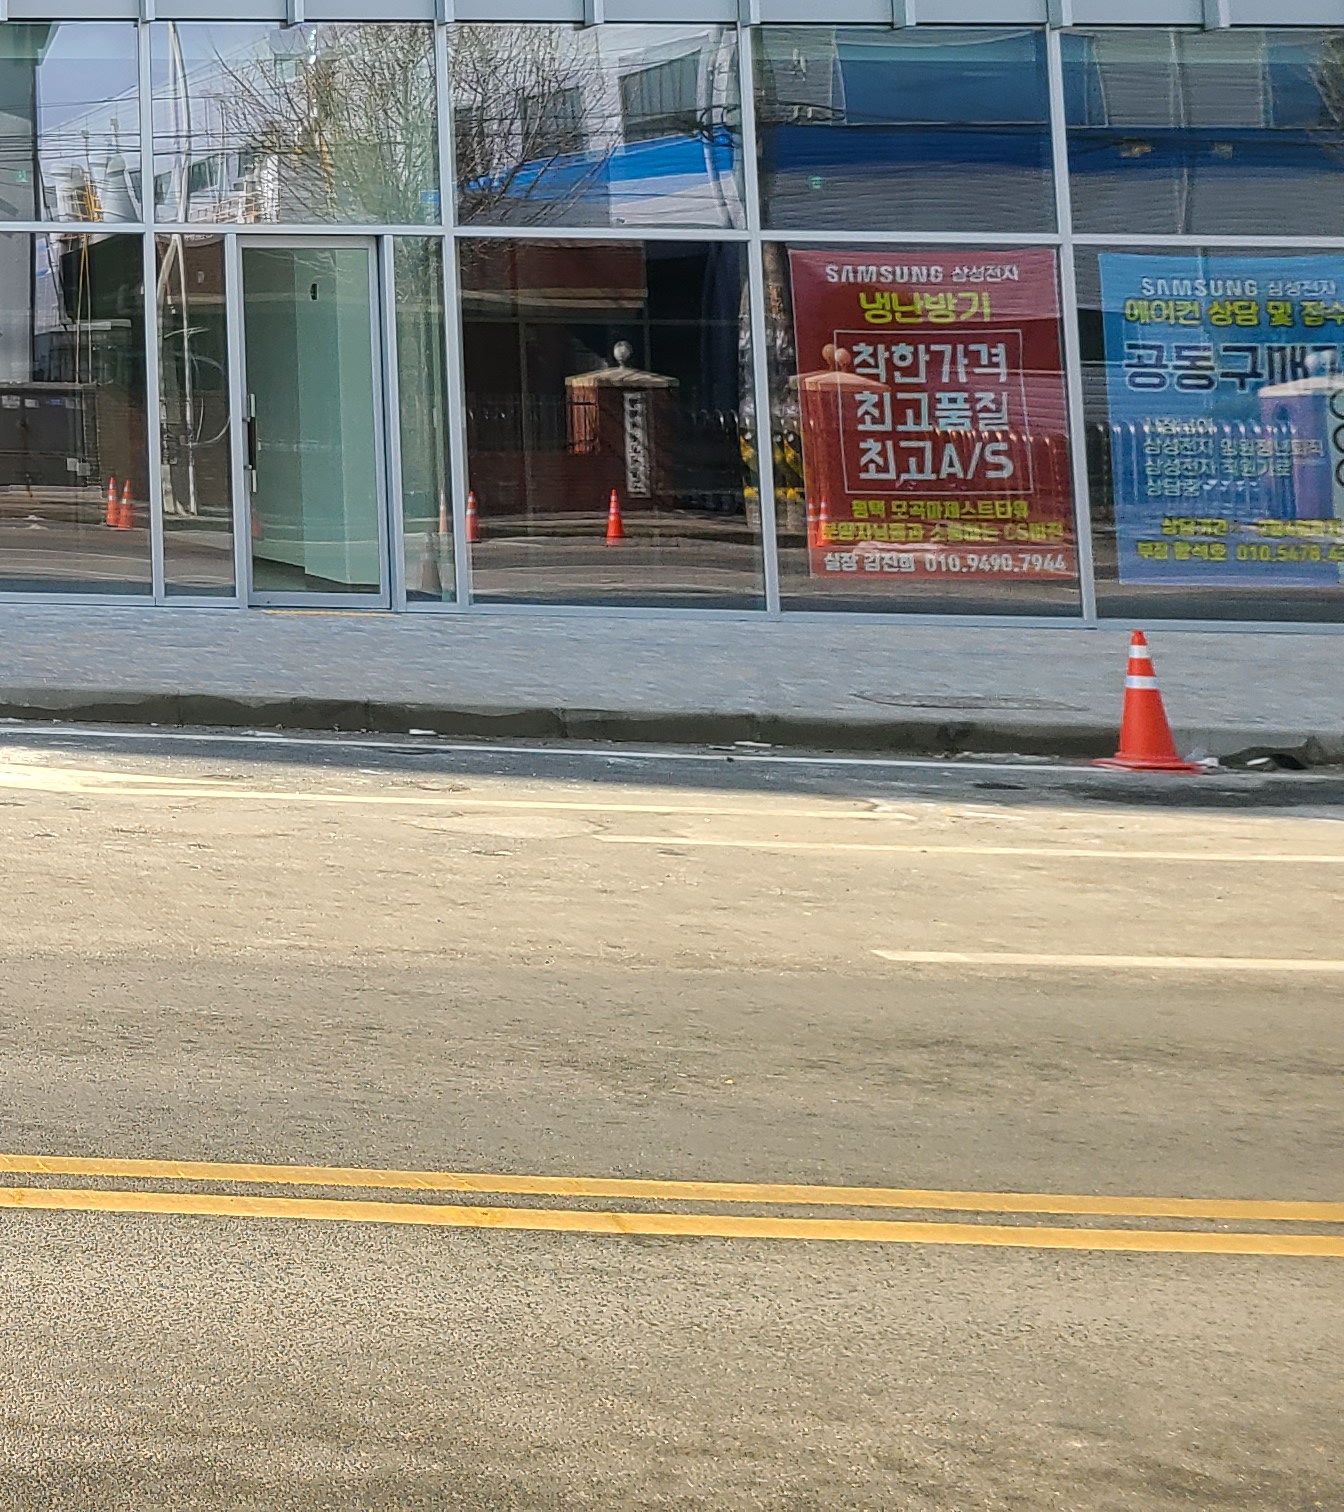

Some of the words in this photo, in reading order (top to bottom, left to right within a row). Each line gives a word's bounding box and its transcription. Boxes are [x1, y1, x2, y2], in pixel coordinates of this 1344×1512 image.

[825, 265, 944, 283] SAMSUNG
[951, 264, 1019, 282] 삼성전자
[1141, 277, 1258, 296] SAMSUNG
[1267, 280, 1336, 297] 삼성전자
[859, 291, 991, 324] 냉난방기
[1125, 298, 1201, 325] 에어컨
[1208, 300, 1259, 326] 상담
[1266, 300, 1294, 326] 및
[852, 341, 1008, 384] 착한가격
[855, 390, 1010, 432] 최고품질
[859, 439, 1015, 481] 최고A/S
[1144, 438, 1214, 456] 삼성전자
[1145, 458, 1216, 476] 삼성전자
